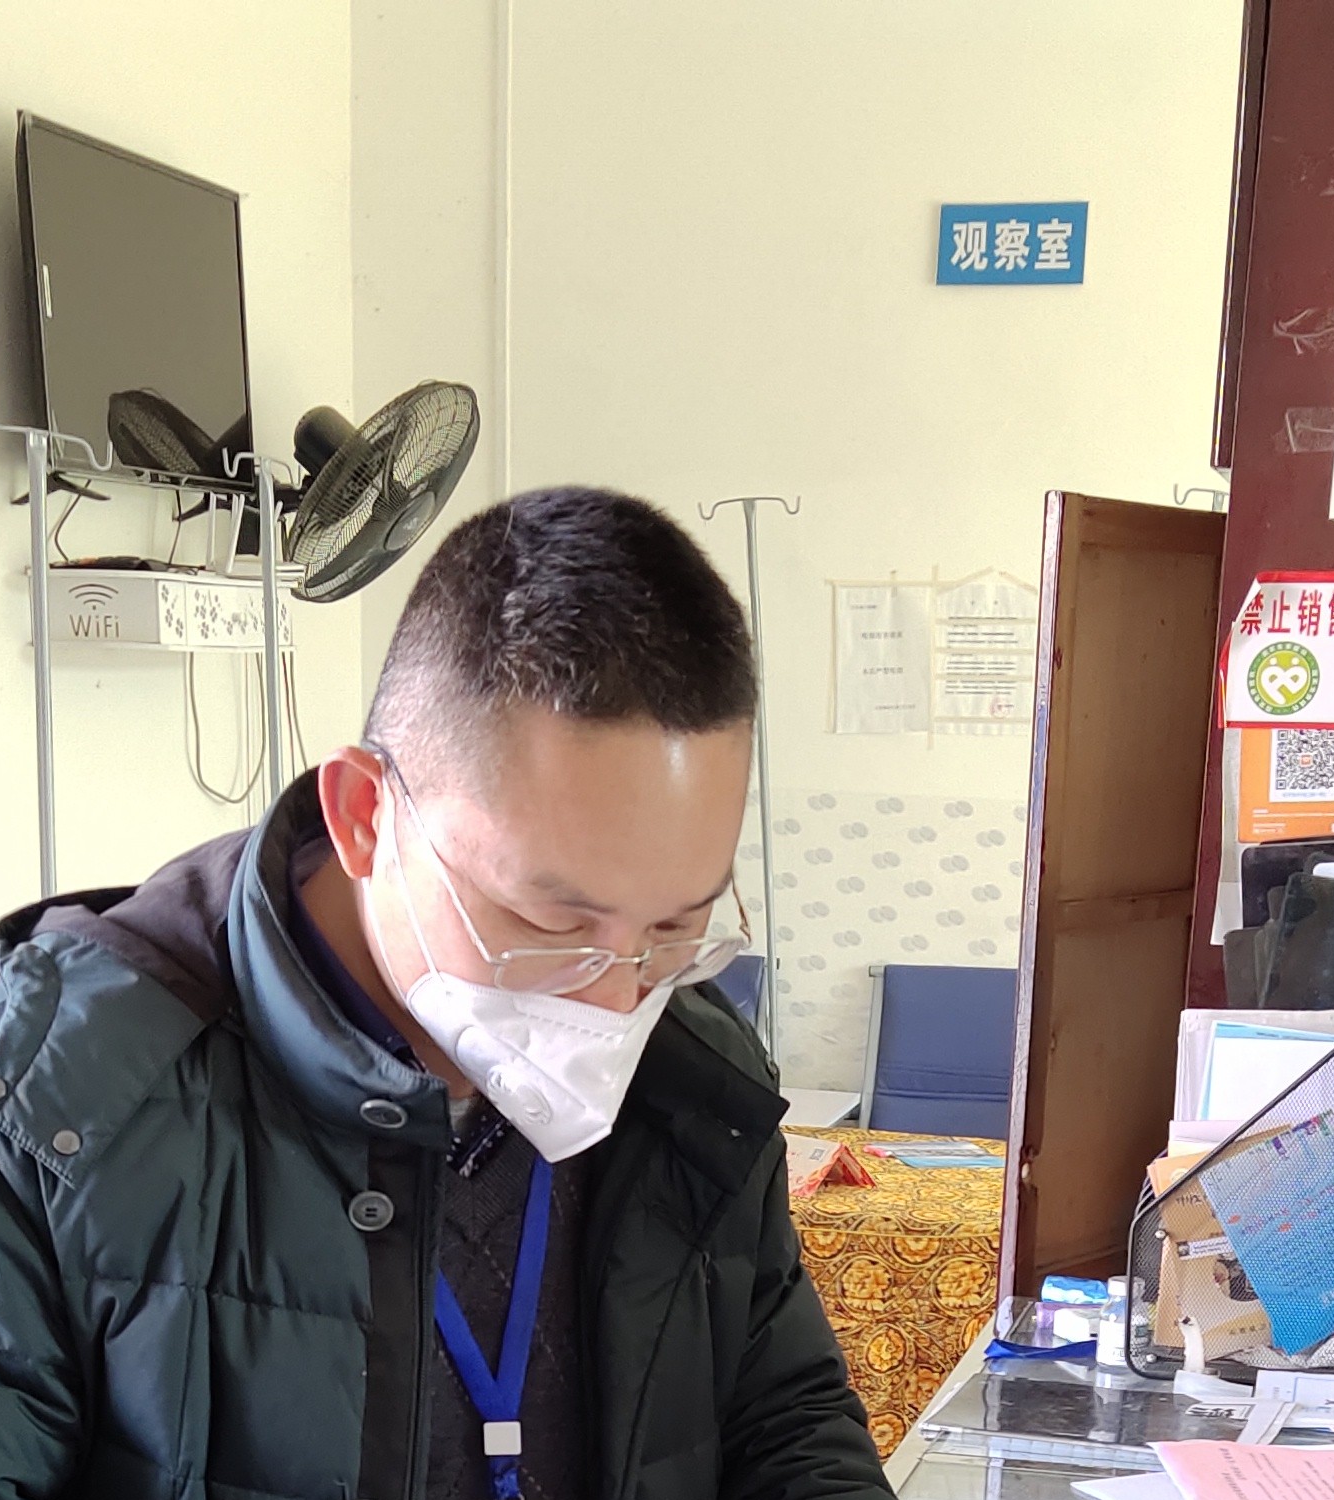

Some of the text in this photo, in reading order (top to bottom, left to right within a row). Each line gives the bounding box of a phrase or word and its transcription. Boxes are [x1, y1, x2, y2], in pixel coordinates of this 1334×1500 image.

[951, 219, 1072, 271] 观察室
[69, 614, 120, 639] WiFi
